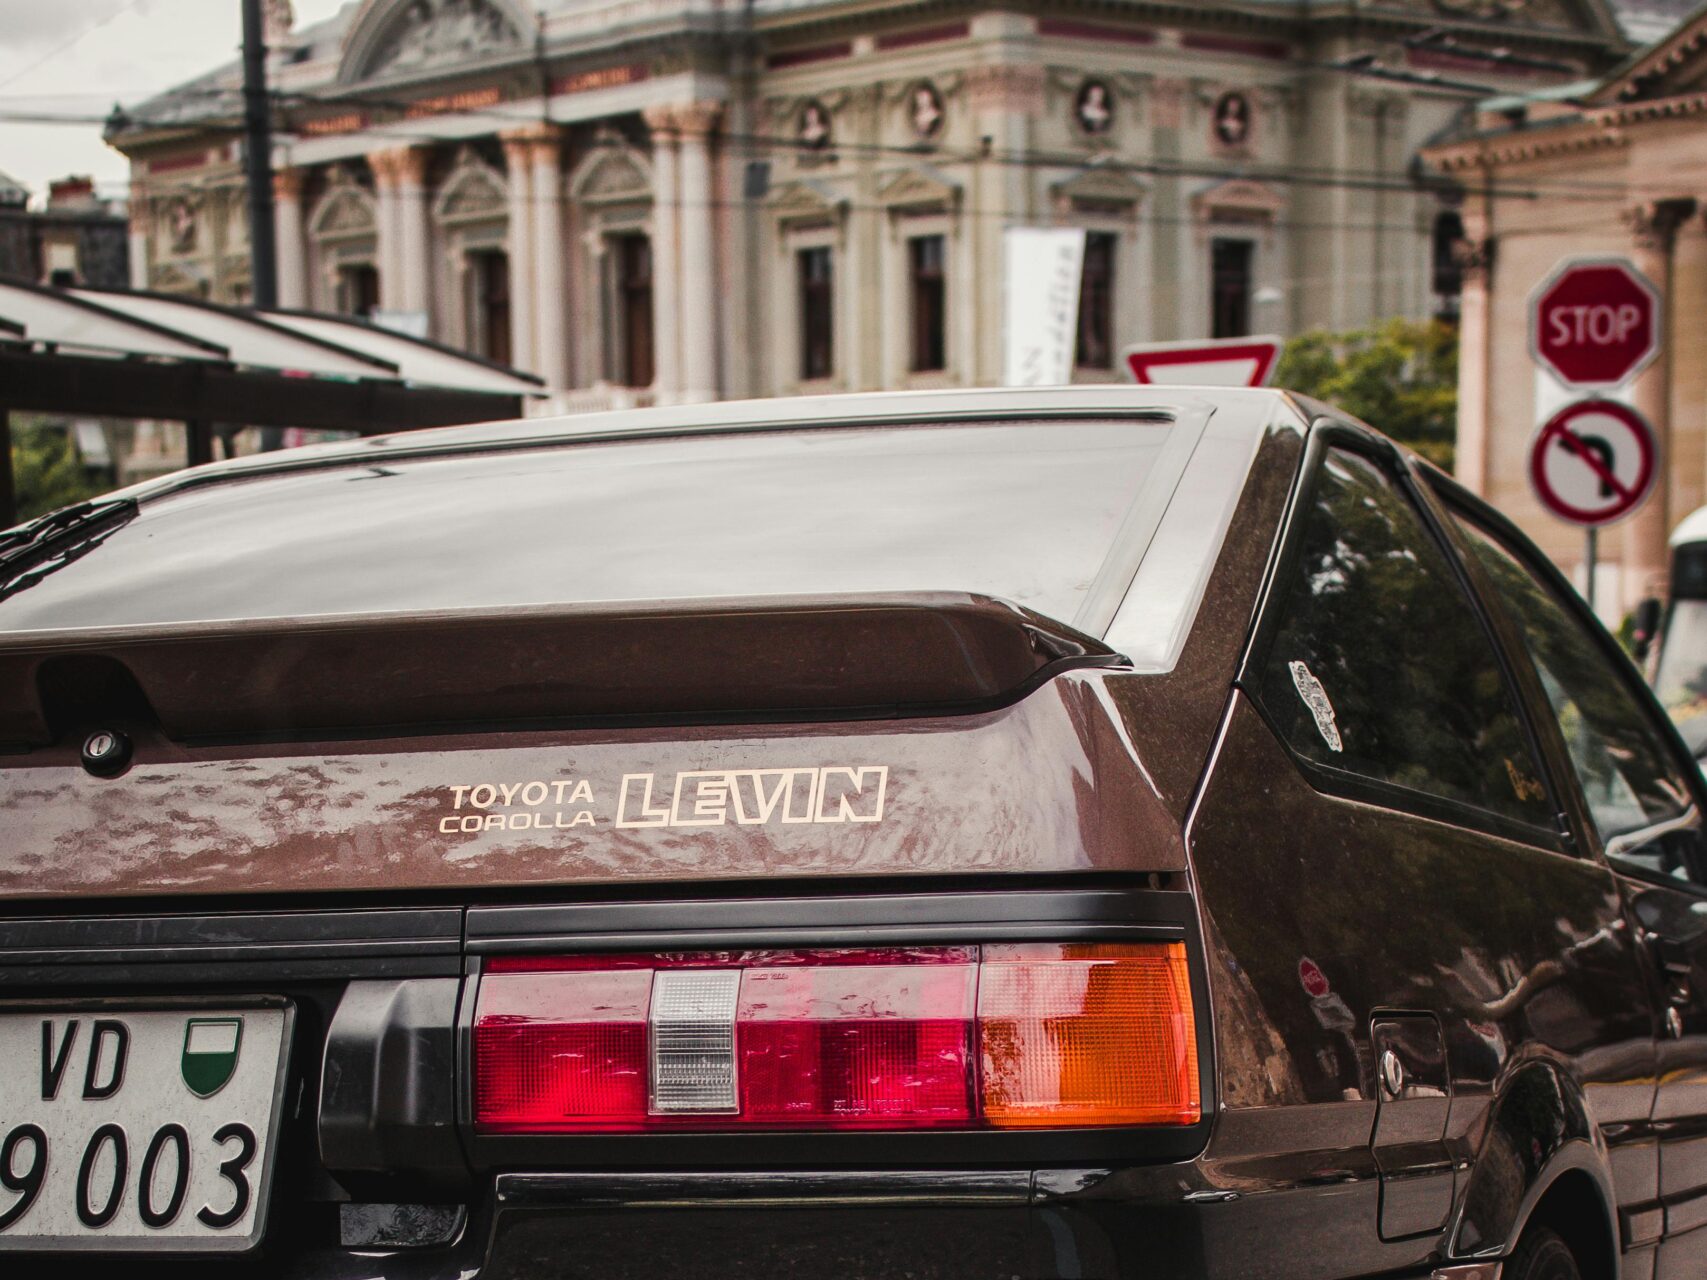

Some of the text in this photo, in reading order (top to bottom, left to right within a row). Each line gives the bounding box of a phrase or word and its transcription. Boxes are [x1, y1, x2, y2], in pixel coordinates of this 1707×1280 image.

[1549, 303, 1640, 347] STOP
[449, 780, 595, 810] TOYOTA
[615, 765, 888, 829] LEVIN
[439, 810, 596, 834] COROLLA
[41, 1019, 131, 1101] VD
